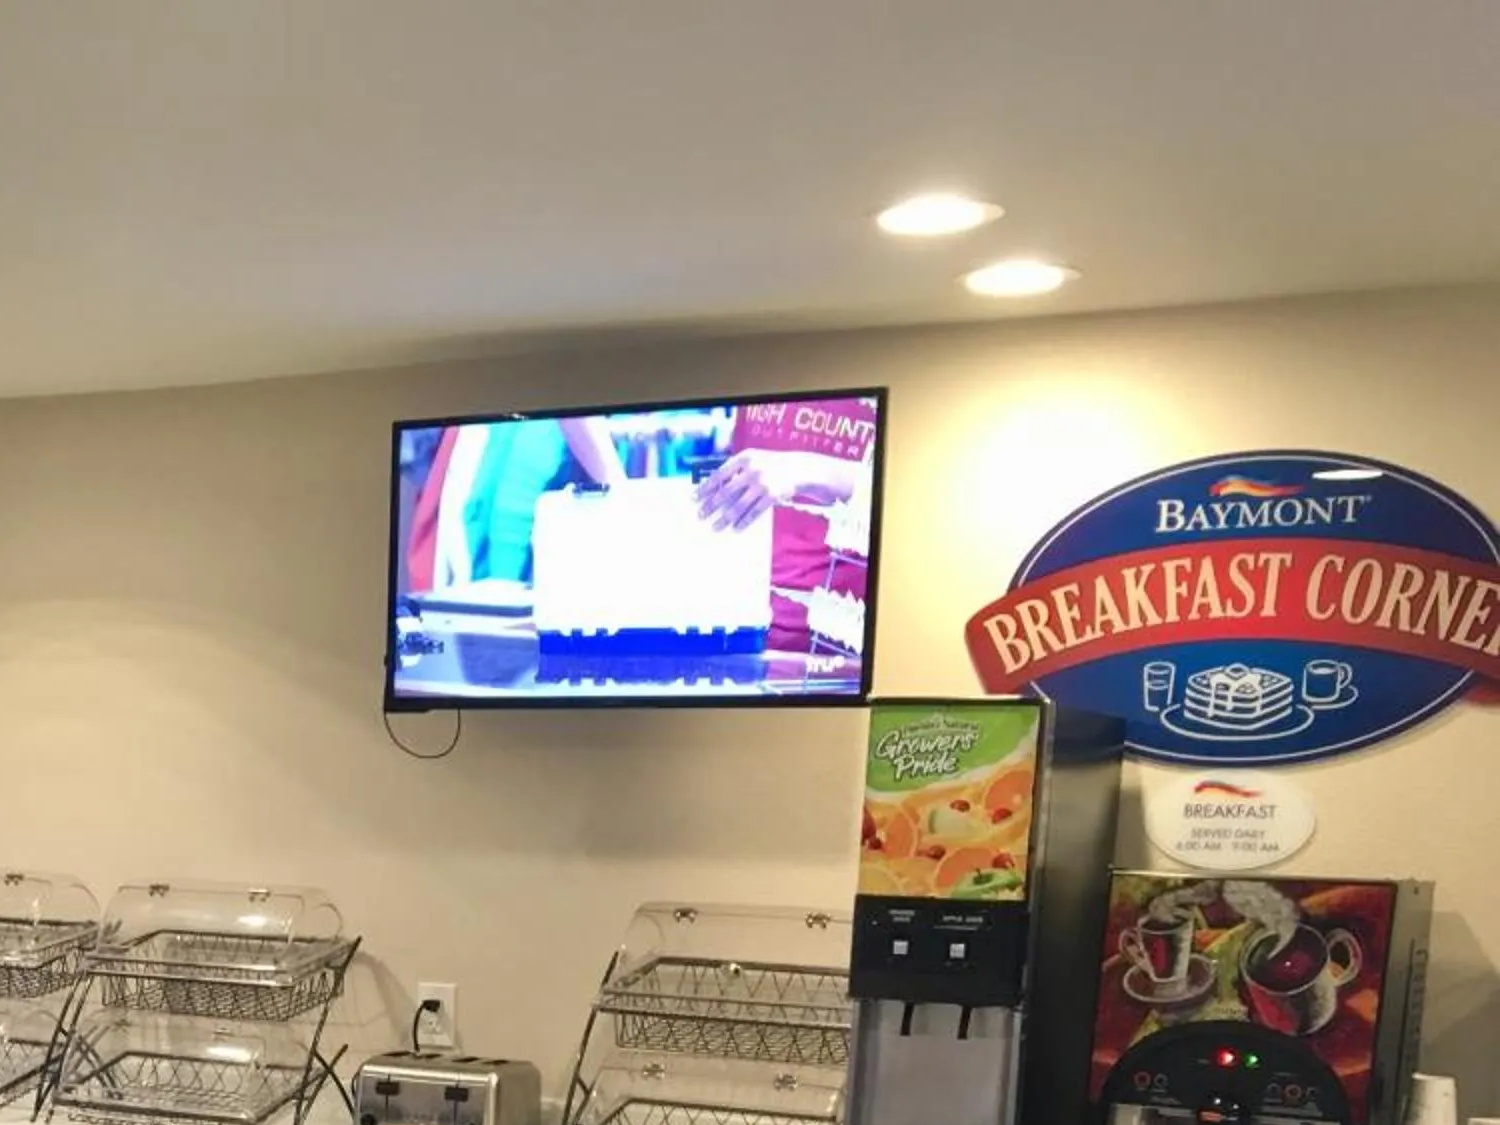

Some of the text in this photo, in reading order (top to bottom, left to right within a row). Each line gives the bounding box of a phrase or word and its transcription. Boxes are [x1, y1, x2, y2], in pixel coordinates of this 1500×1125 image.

[1155, 495, 1366, 534] BAYMONT
[983, 552, 1500, 675] BREAKFAST CORNE
[893, 751, 958, 781] Pride
[1183, 803, 1278, 819] BREAKFAST
